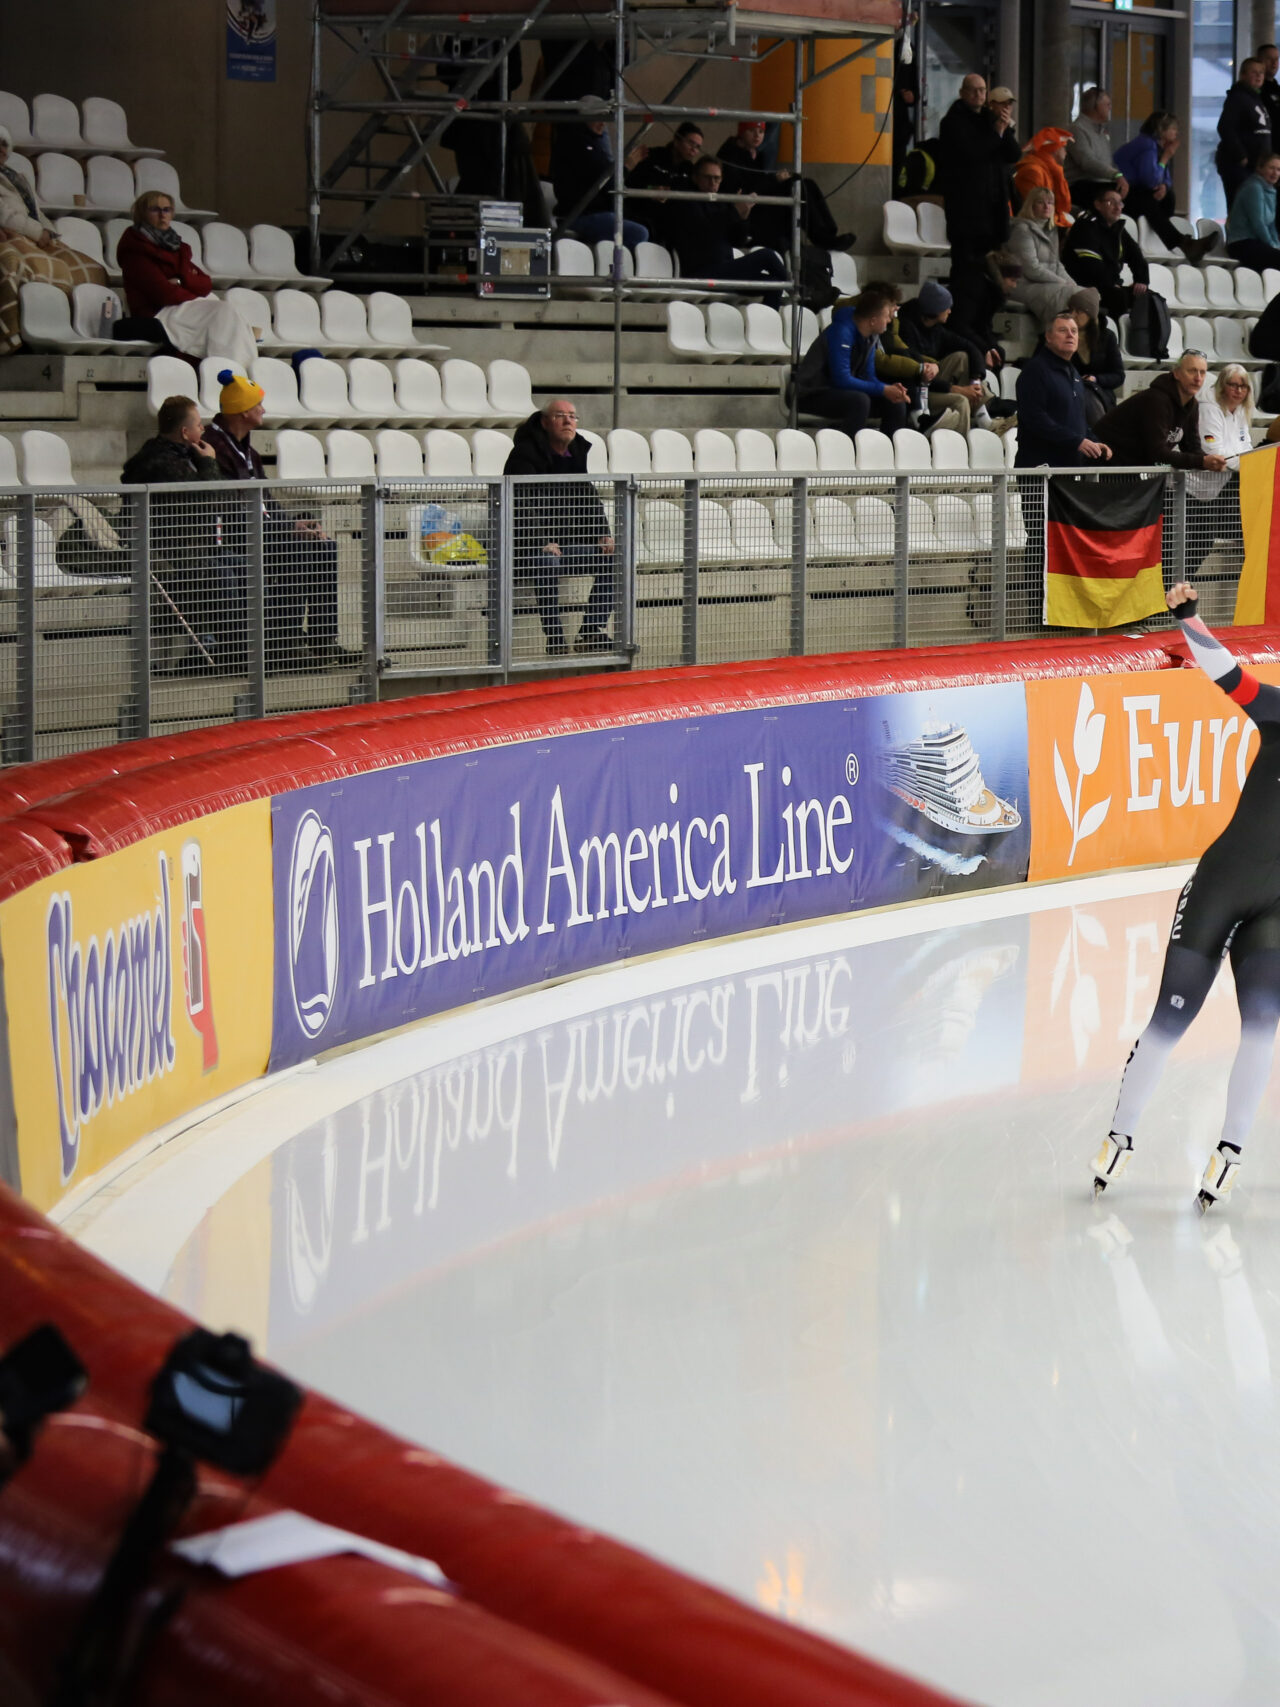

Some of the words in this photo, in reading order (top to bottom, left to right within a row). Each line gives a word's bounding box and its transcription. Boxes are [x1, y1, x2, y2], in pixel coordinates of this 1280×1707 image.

[41, 365, 52, 381] 4
[354, 801, 531, 989] Holland
[538, 784, 737, 935] America
